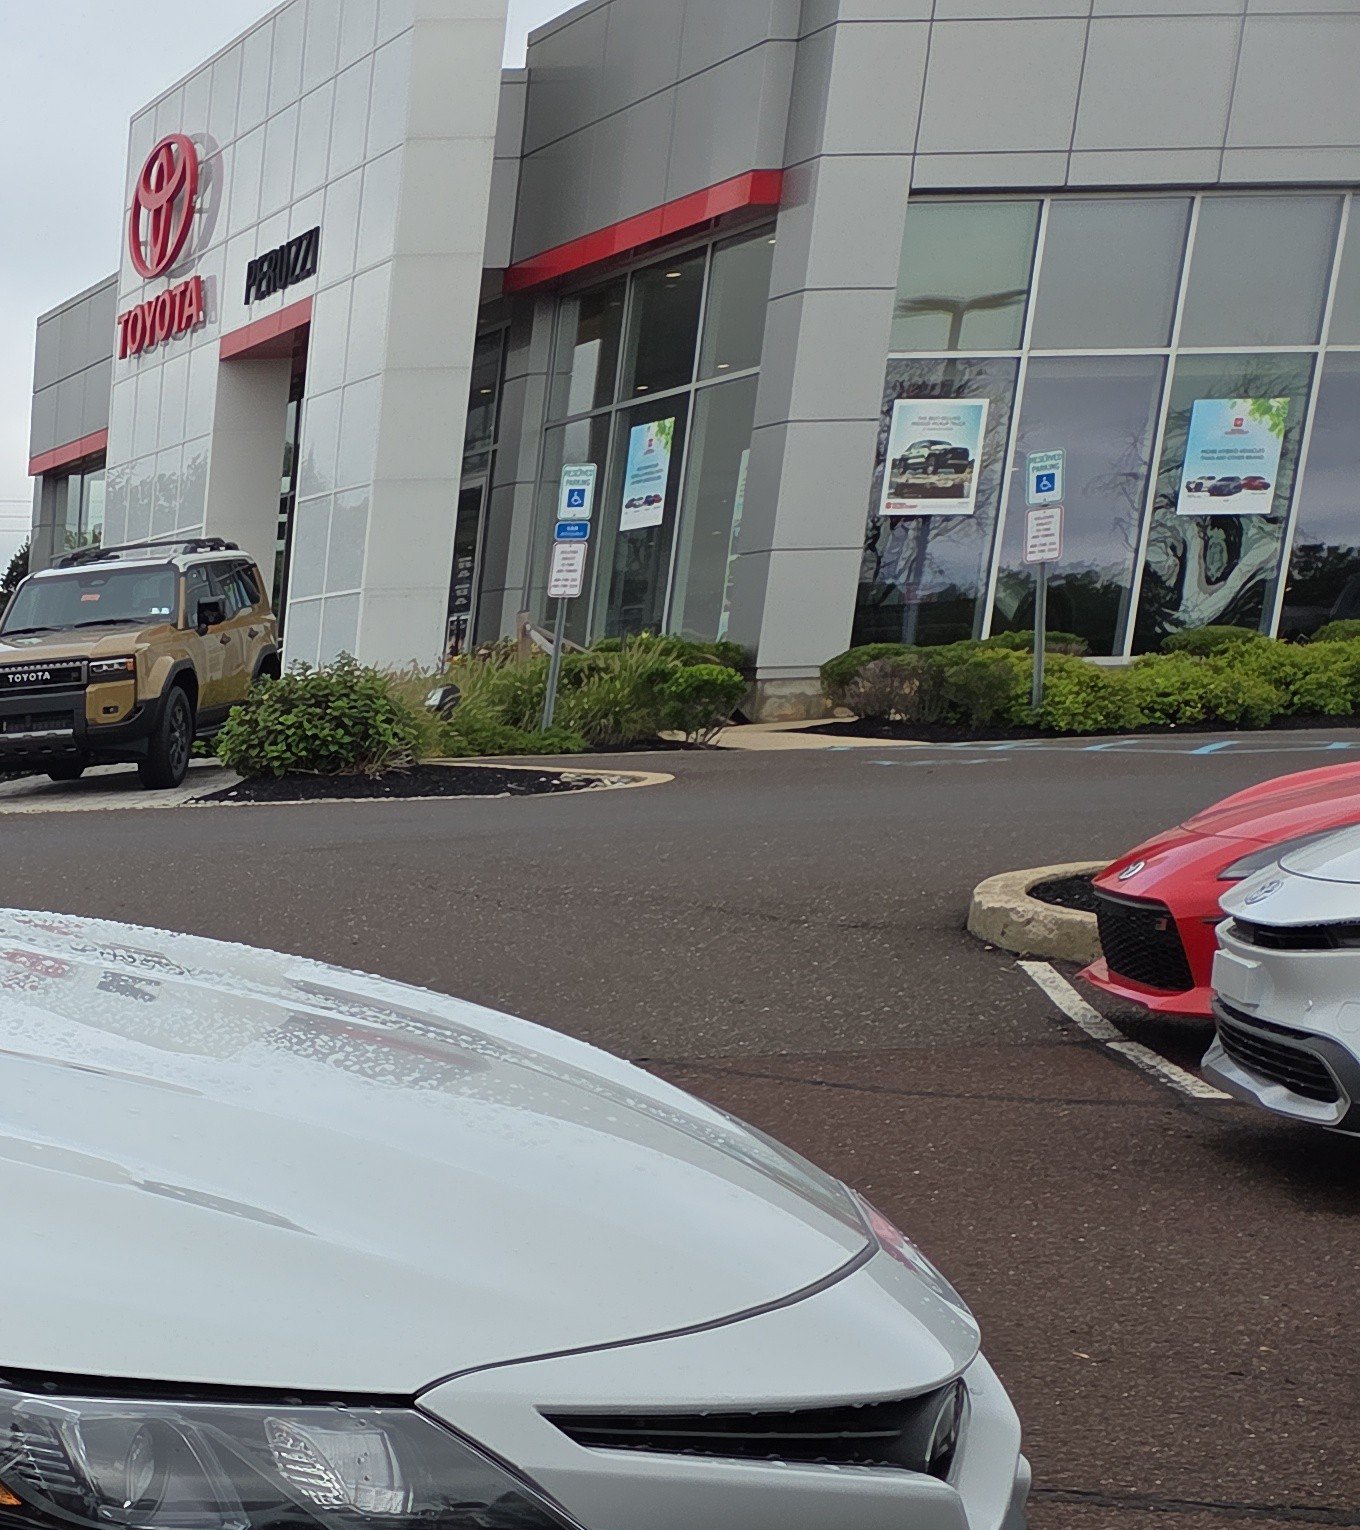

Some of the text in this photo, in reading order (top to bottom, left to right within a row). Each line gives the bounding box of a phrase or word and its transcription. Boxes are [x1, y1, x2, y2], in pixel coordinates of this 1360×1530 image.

[244, 226, 320, 305] PERUZZI
[117, 275, 205, 360] TOYOTA
[7, 671, 51, 683] TOYOTA
